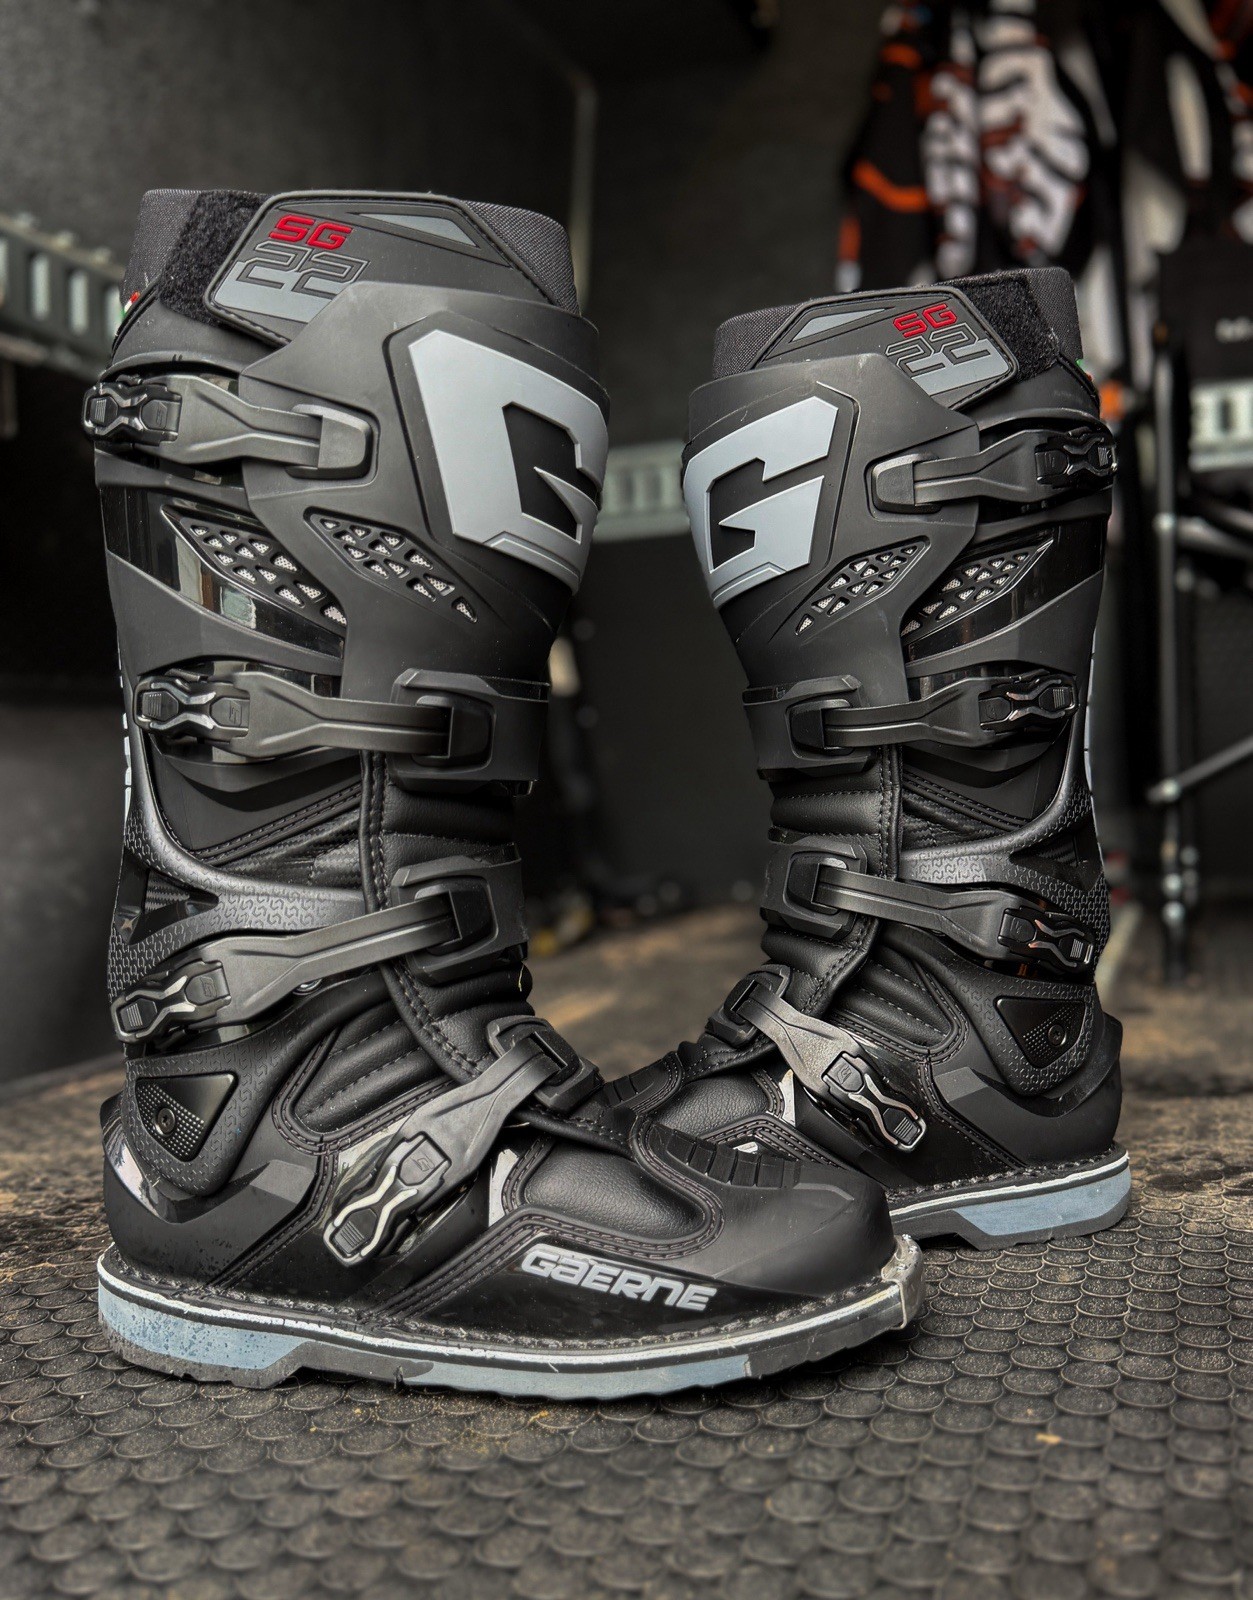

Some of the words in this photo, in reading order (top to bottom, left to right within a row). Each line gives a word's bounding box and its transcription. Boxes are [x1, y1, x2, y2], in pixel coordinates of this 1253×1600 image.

[269, 214, 353, 250] SG
[236, 240, 371, 301] 22
[893, 303, 957, 338] SG
[885, 322, 992, 378] 22
[683, 395, 838, 608] G
